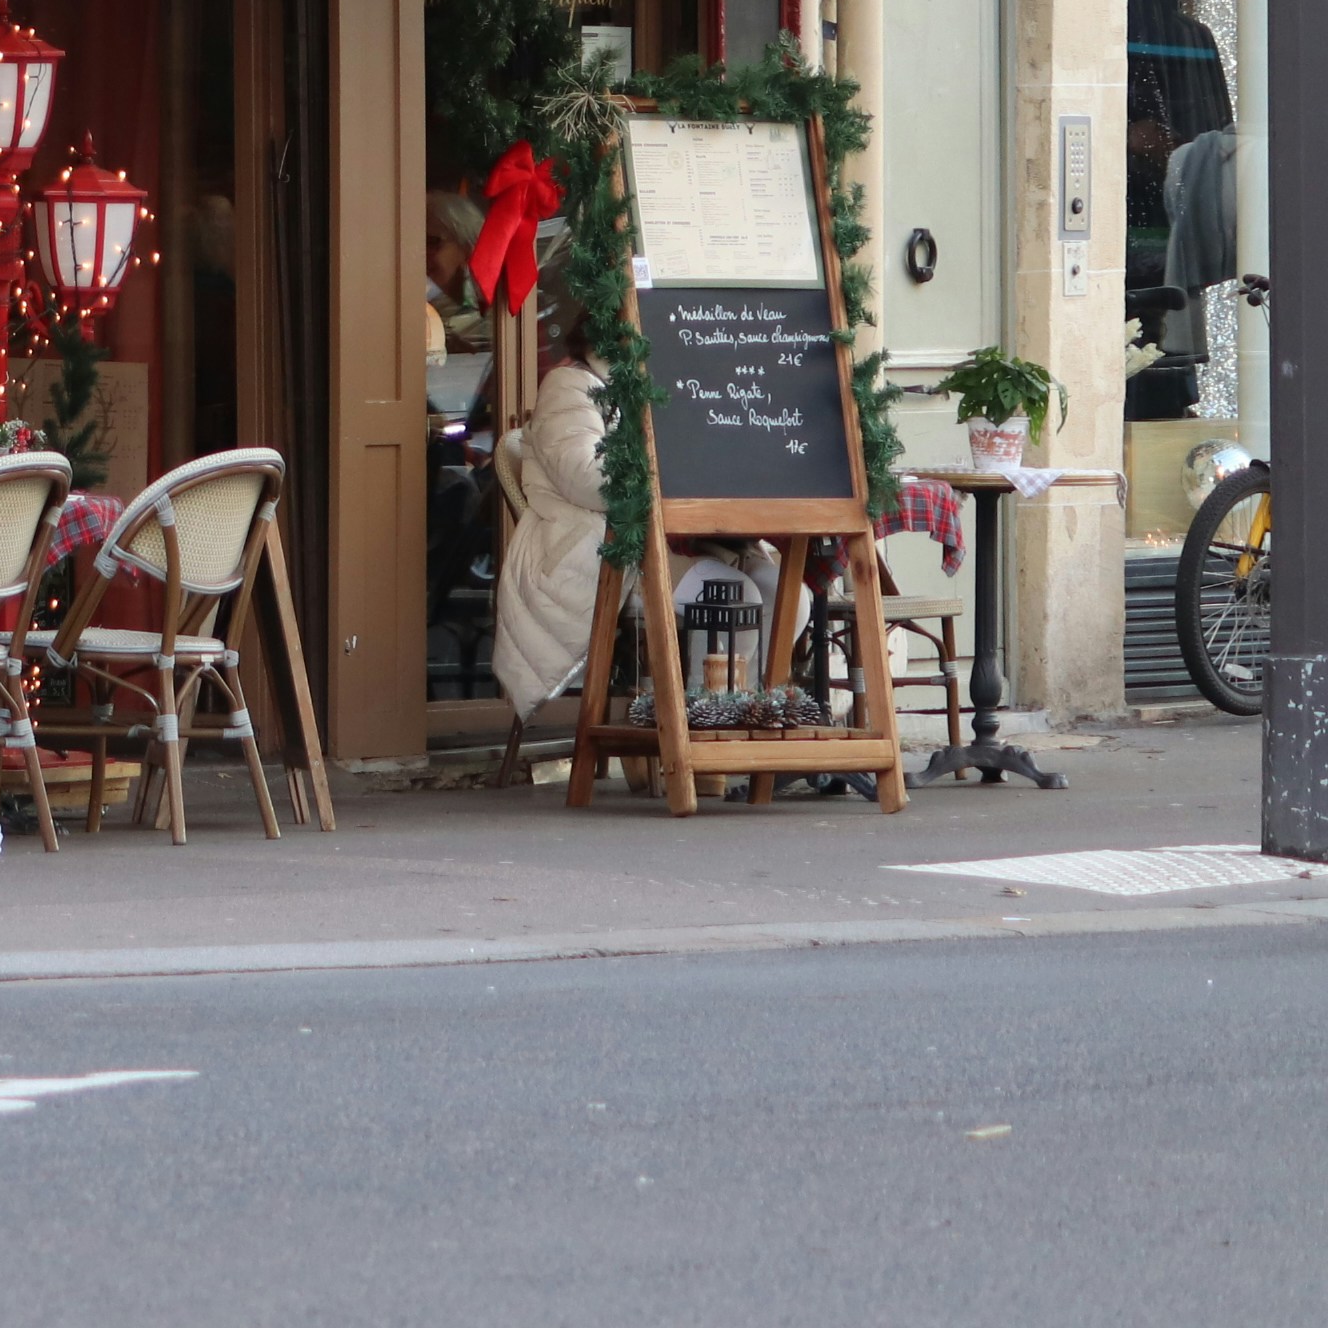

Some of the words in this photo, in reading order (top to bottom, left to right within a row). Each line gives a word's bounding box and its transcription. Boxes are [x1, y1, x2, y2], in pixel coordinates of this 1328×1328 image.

[740, 303, 754, 321] de
[777, 352, 803, 367] 21€
[686, 379, 722, 400] Penne
[706, 408, 743, 426] Sauce
[748, 407, 804, 436] Roquefort
[785, 438, 809, 455] 17€
